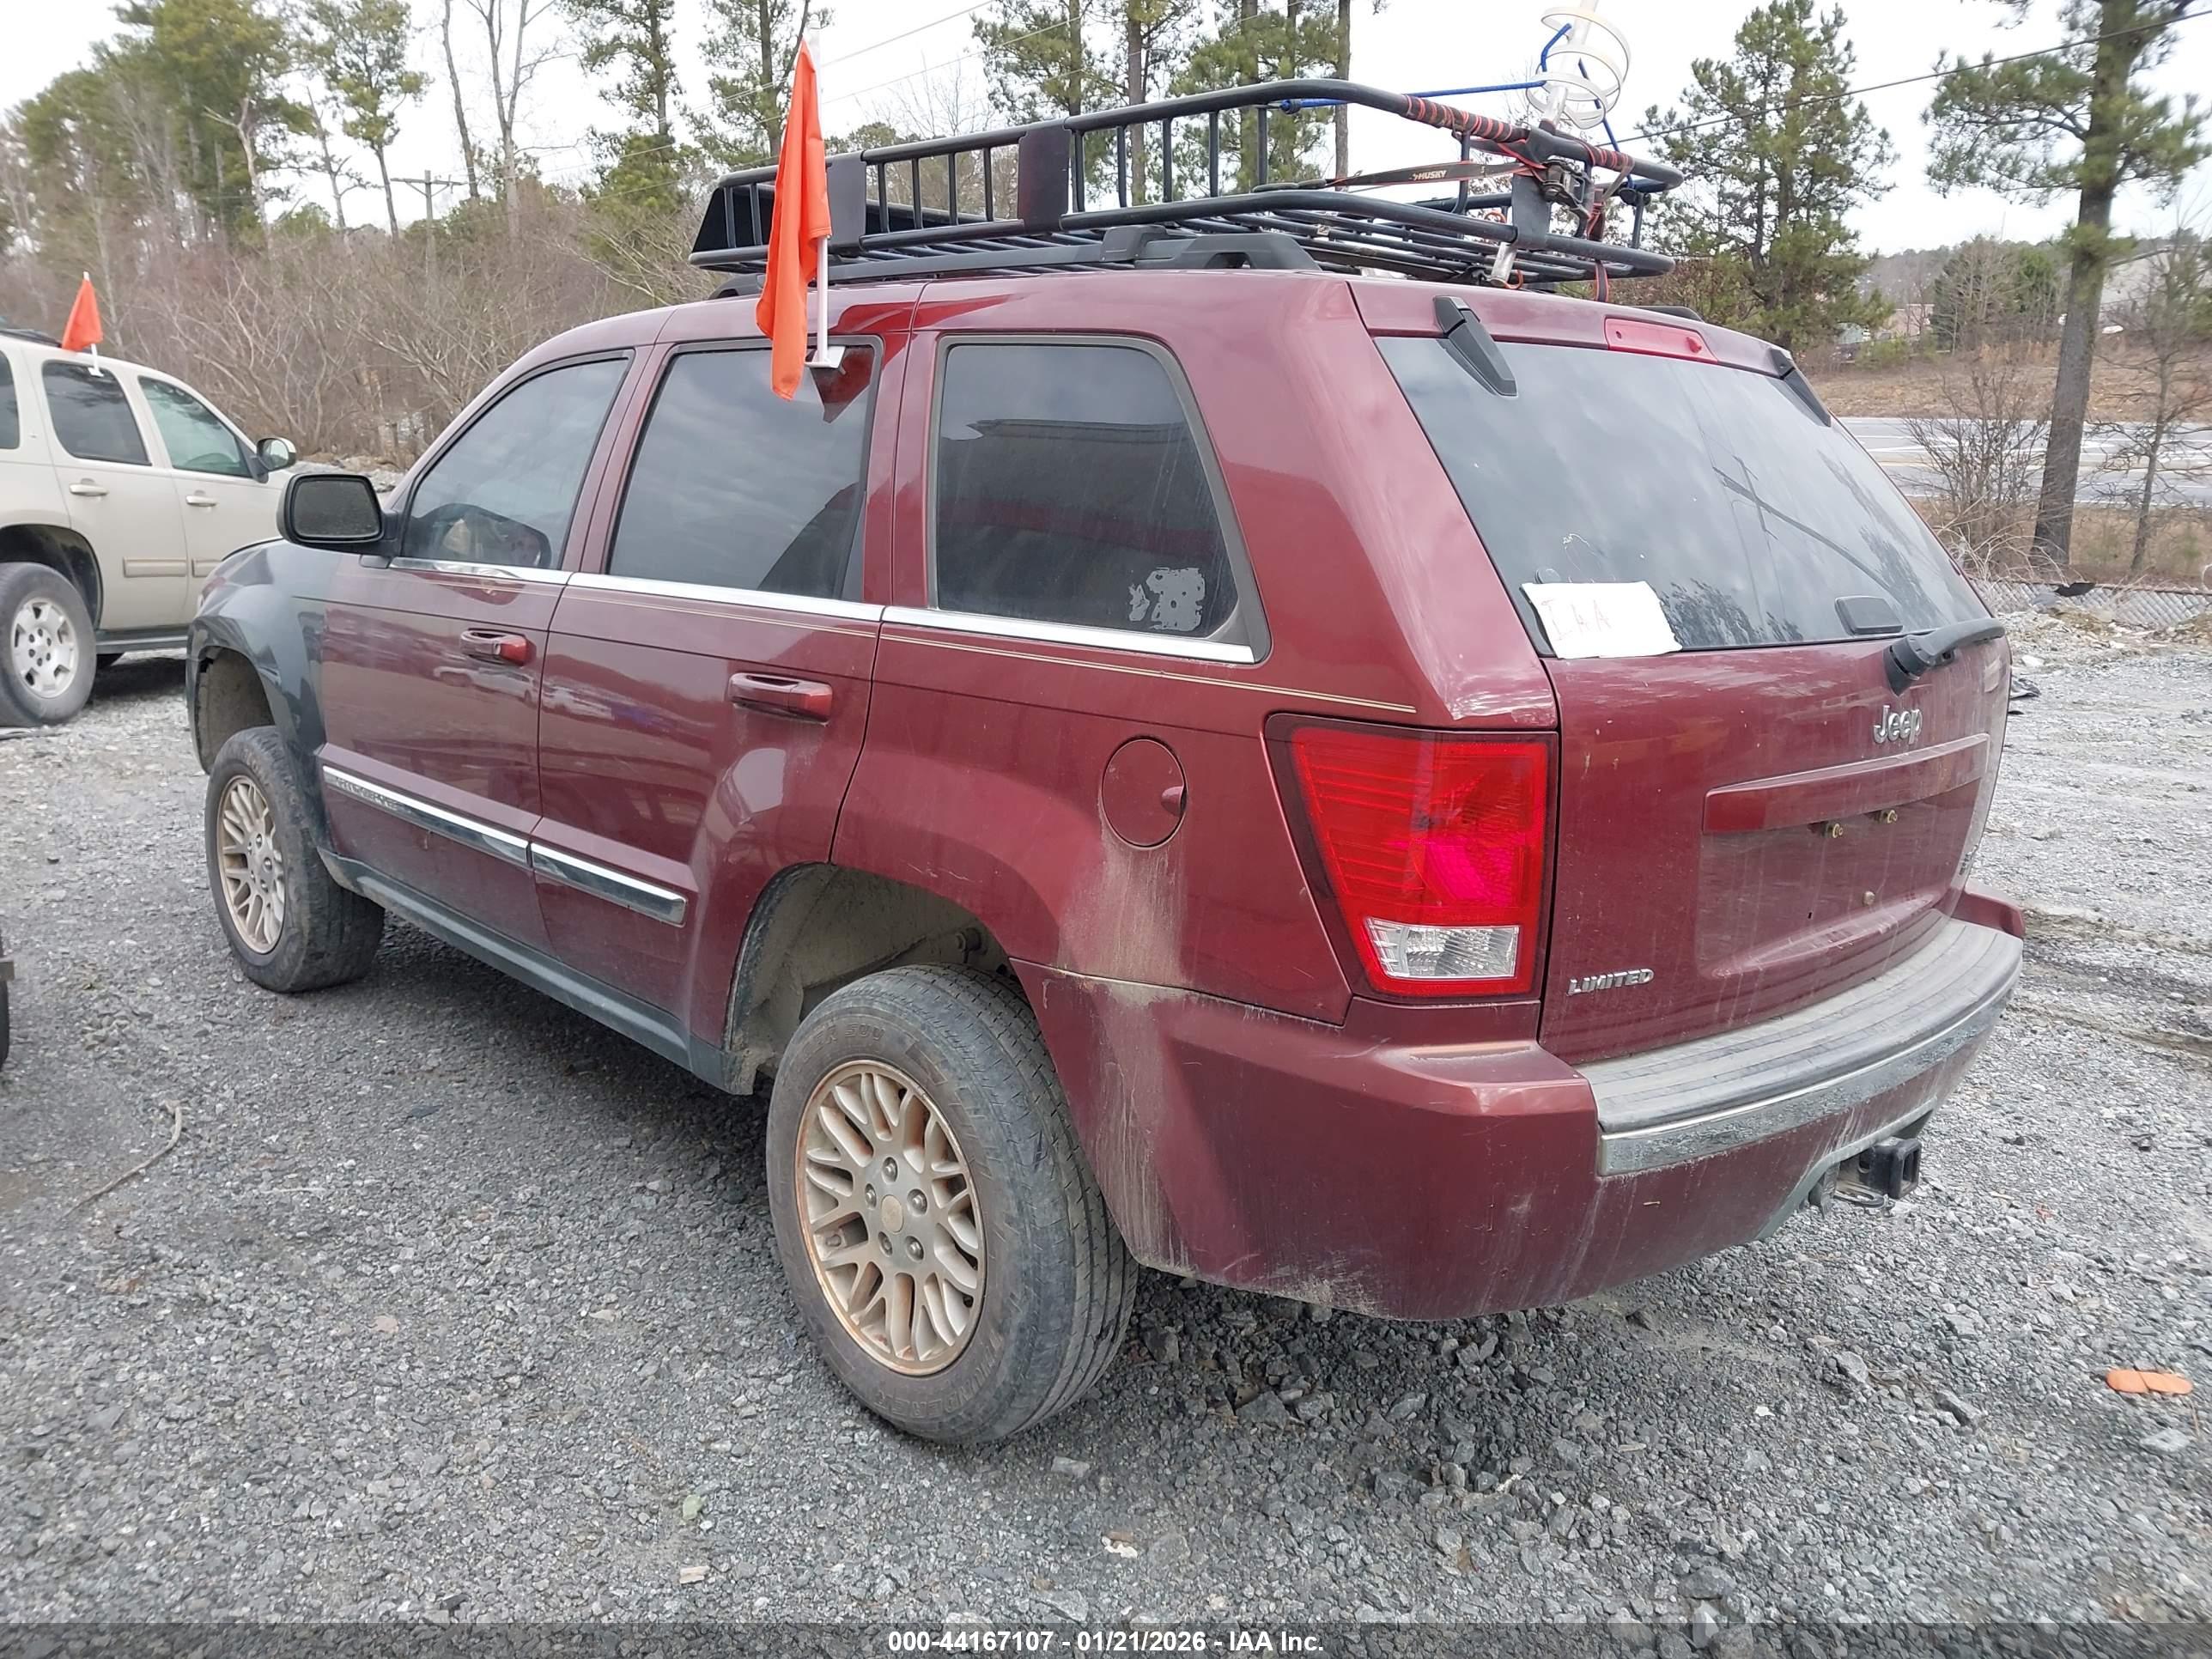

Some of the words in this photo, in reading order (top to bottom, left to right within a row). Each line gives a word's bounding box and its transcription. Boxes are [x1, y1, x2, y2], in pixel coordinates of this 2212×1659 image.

[1417, 169, 1448, 180] HUSKY
[1873, 704, 1923, 744] Jeep
[1567, 968, 1655, 995] LIMITED
